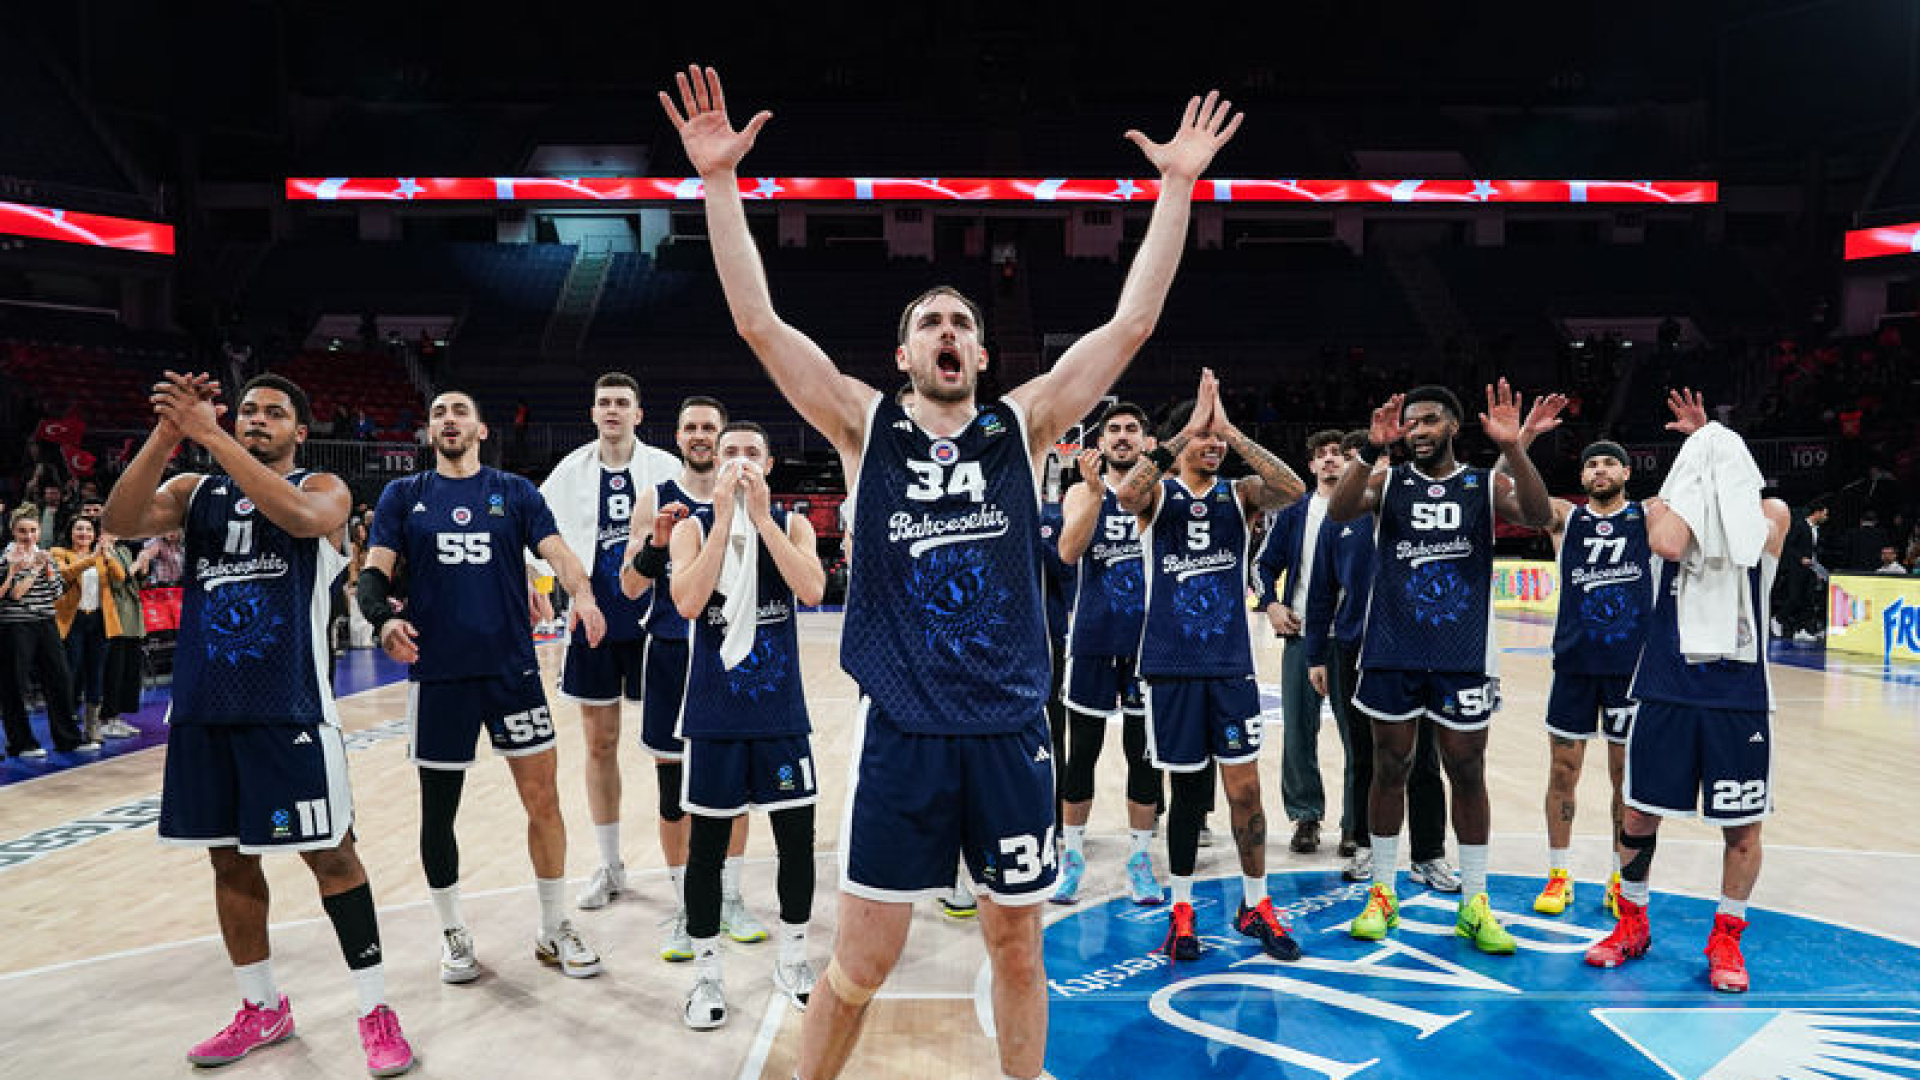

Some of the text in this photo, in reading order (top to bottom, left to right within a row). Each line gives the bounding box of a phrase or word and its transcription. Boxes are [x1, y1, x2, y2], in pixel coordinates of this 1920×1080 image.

[384, 455, 414, 471] 113
[906, 458, 986, 502] 34
[608, 494, 630, 521] 8
[1411, 502, 1461, 530] 50
[224, 520, 253, 555] 11
[1105, 516, 1141, 541] 57
[1187, 521, 1211, 551] 5
[437, 532, 492, 564] 55
[1583, 537, 1627, 564] 77
[503, 706, 553, 743] 55
[798, 756, 814, 792] 1
[1712, 780, 1765, 811] 22
[295, 798, 330, 836] 11
[998, 826, 1057, 885] 34
